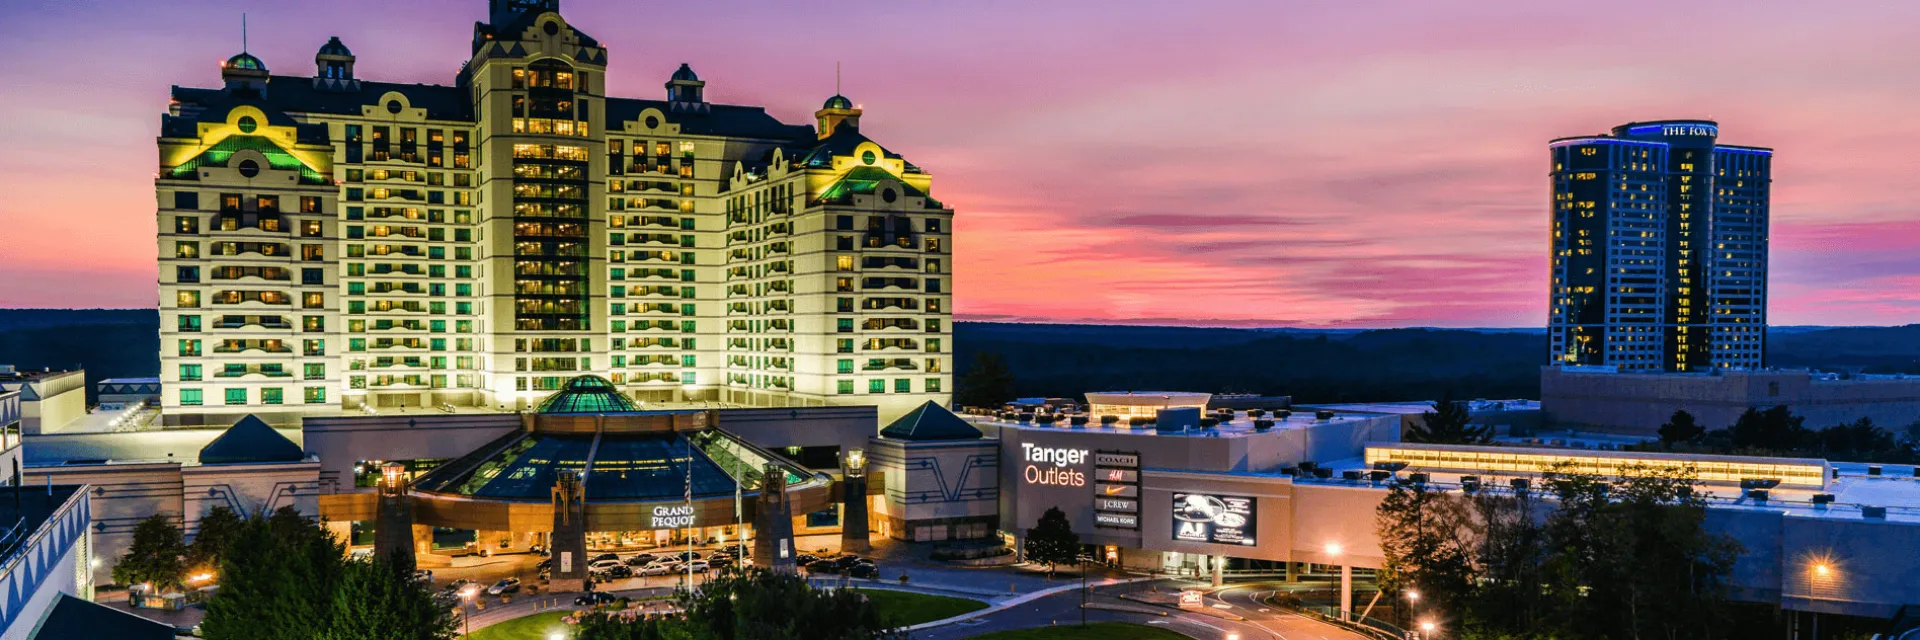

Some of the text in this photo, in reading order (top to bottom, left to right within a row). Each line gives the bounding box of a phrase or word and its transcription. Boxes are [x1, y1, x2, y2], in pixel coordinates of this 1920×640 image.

[1664, 126, 1686, 136] THE
[1689, 126, 1708, 136] FOX
[1021, 442, 1088, 467] Tanger
[1025, 465, 1085, 486] Outlets
[1103, 500, 1129, 510] J.CREW
[653, 506, 694, 516] GRAND
[652, 515, 695, 527] PEQUOT
[1097, 515, 1119, 524] MICHAEL
